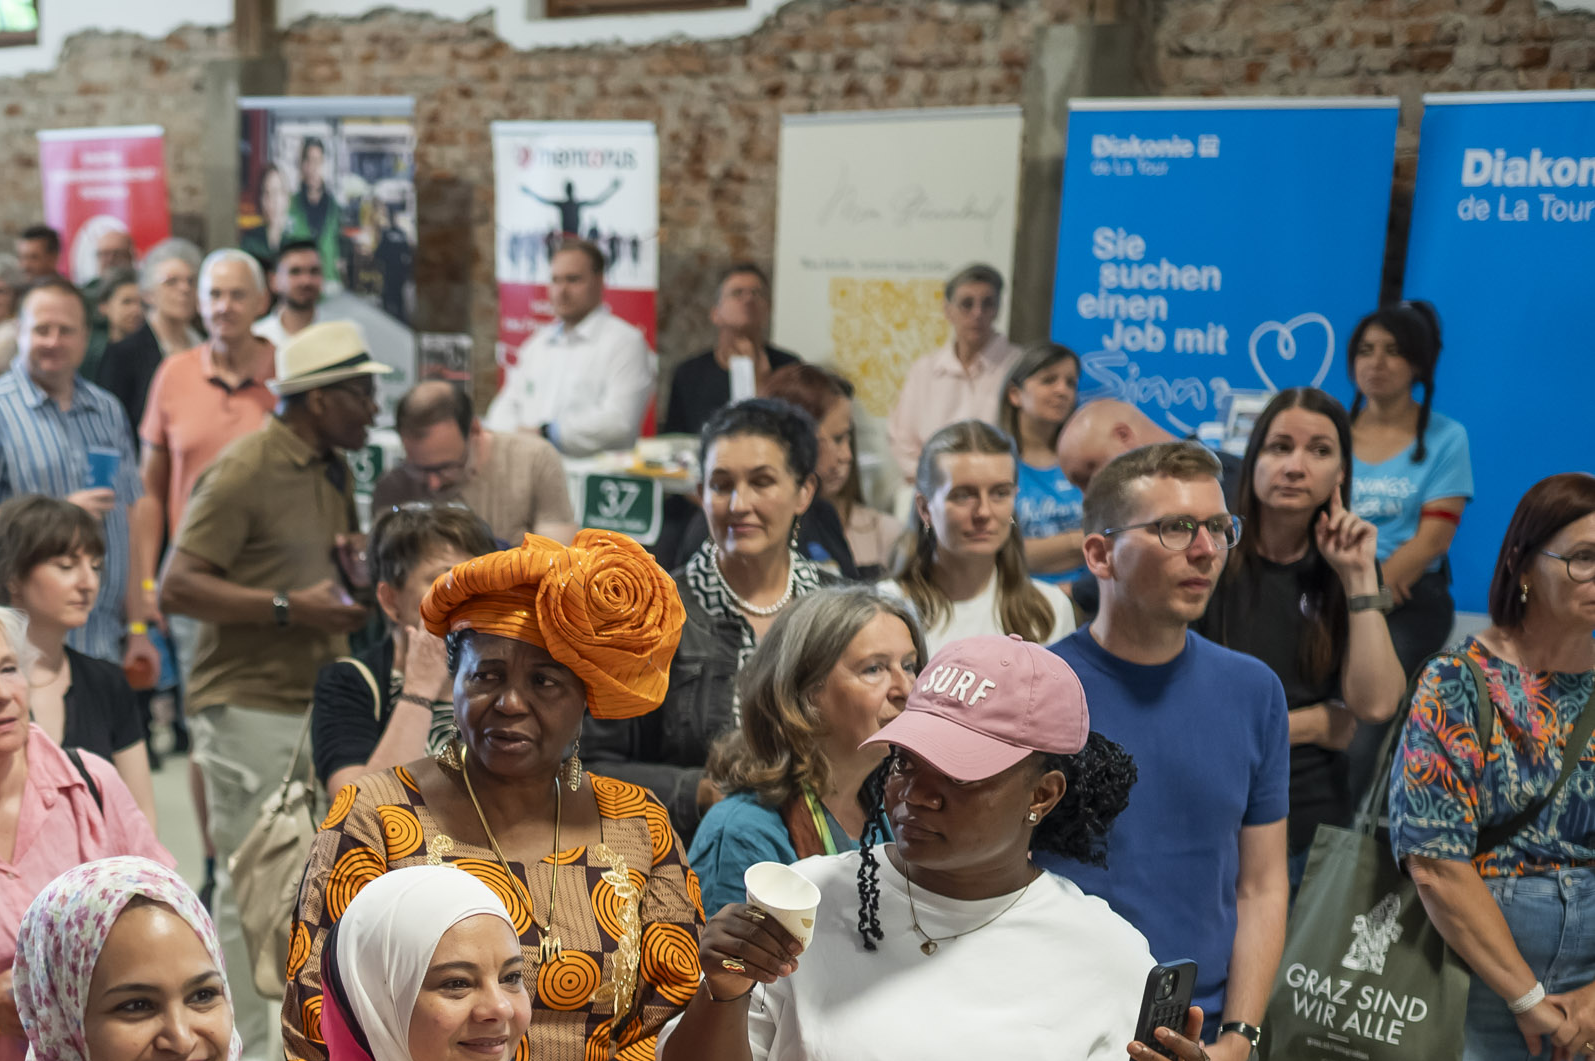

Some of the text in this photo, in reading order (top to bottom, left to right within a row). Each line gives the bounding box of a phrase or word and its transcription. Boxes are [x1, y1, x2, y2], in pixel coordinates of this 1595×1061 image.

[1091, 134, 1195, 158] Diakonie
[1457, 193, 1595, 222] de La Tour
[1093, 226, 1146, 260] Sie
[1099, 257, 1222, 291] suchen
[1077, 286, 1168, 321] einen
[1102, 319, 1229, 355] Job mit
[596, 479, 642, 518] 37
[921, 665, 996, 706] SURF
[1286, 962, 1428, 1023] GRAZ SIND
[1293, 989, 1405, 1046] WIR ALLE
